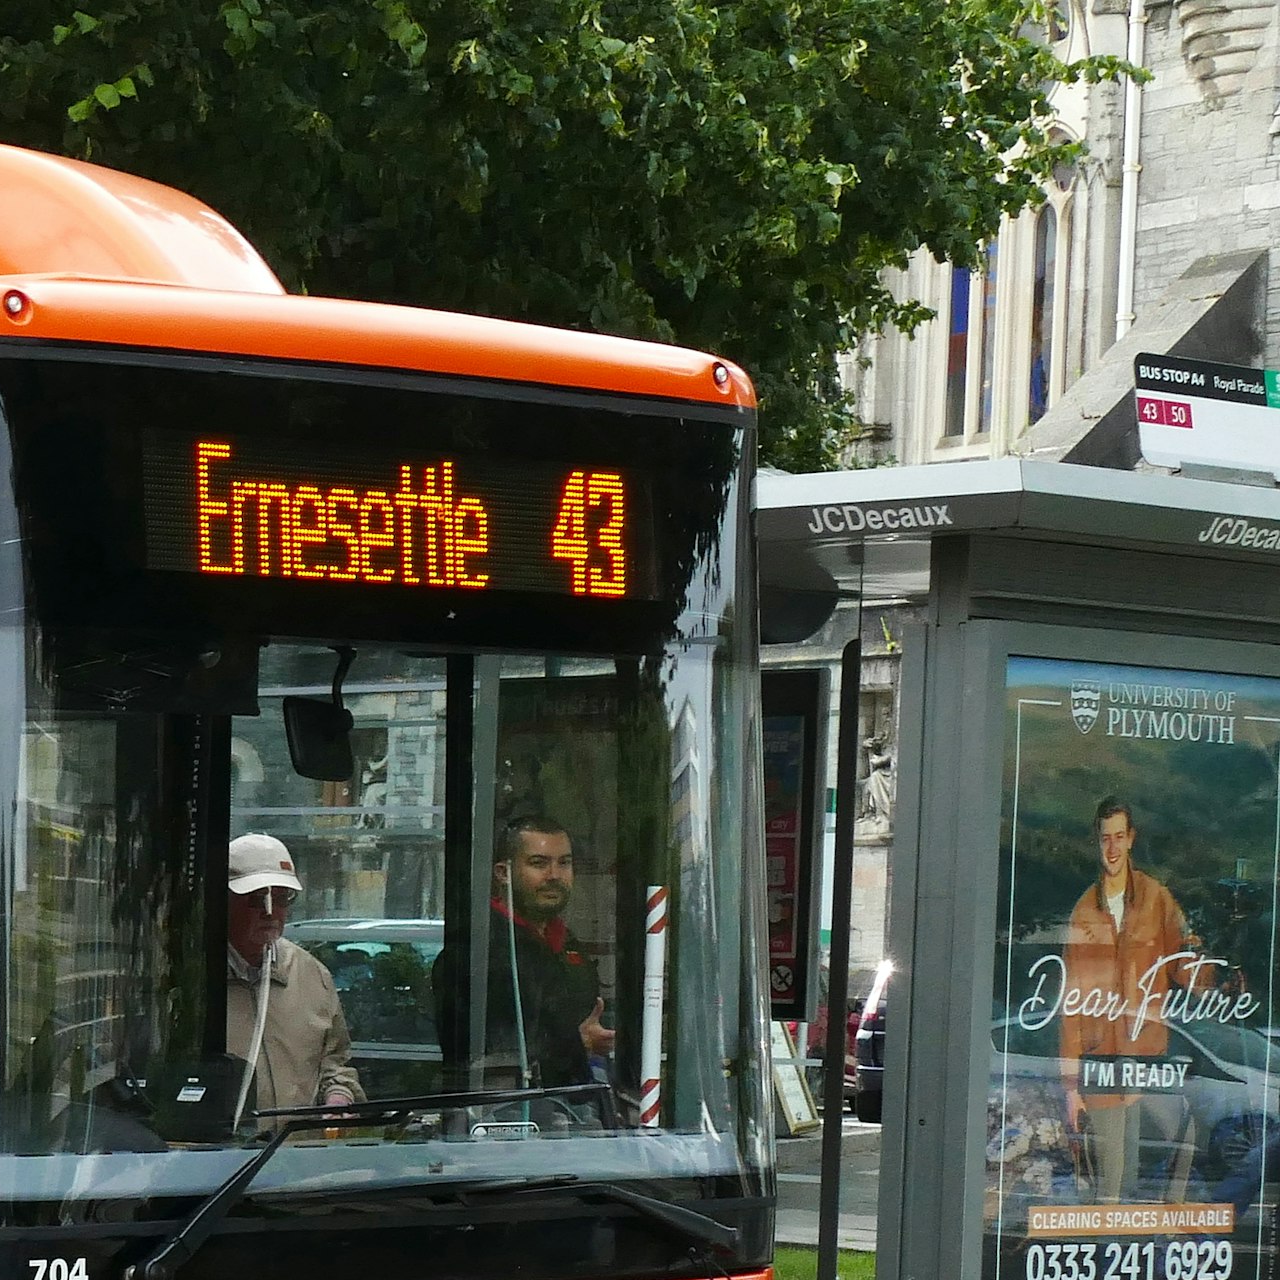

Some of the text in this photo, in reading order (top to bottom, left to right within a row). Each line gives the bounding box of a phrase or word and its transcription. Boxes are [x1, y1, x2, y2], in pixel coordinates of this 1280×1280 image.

[1140, 365, 1161, 380] BUS
[1163, 368, 1190, 384] STOP
[1191, 373, 1206, 386] A4
[1213, 375, 1236, 393] Royal
[1237, 379, 1265, 395] Parade
[1143, 402, 1158, 420] 43
[1171, 406, 1186, 423] 50
[197, 442, 627, 595] Ernesettle 43
[808, 503, 953, 534] JCDecaux
[1109, 683, 1236, 712] UNIVERSITY OF
[1106, 707, 1236, 745] PLYMOUTH
[1018, 951, 1260, 1042] Dear Future
[1083, 1063, 1188, 1087] I'M READY
[1033, 1209, 1230, 1230] CLEARING SPACES AVAILABLE
